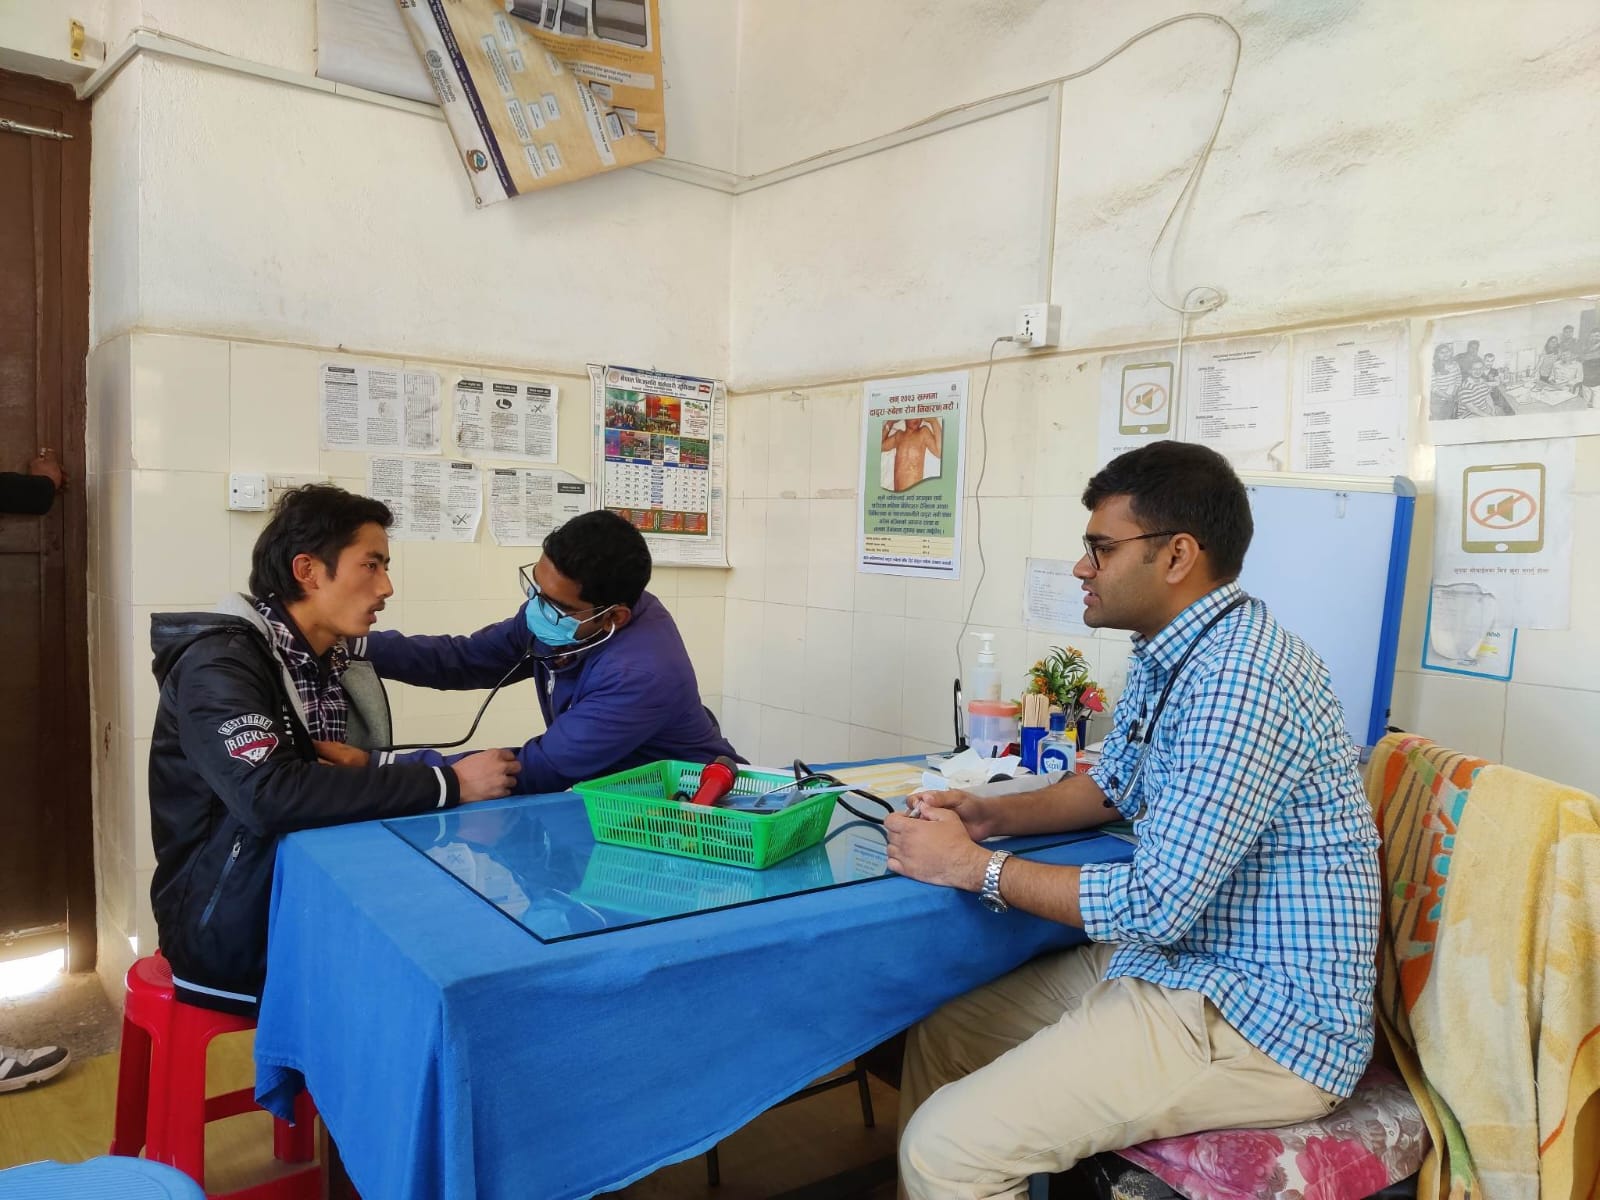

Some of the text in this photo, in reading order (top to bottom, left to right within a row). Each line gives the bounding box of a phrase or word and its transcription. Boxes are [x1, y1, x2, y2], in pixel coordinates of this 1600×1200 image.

[904, 405, 915, 414] रोग
[222, 716, 269, 734] BEST VOGUE
